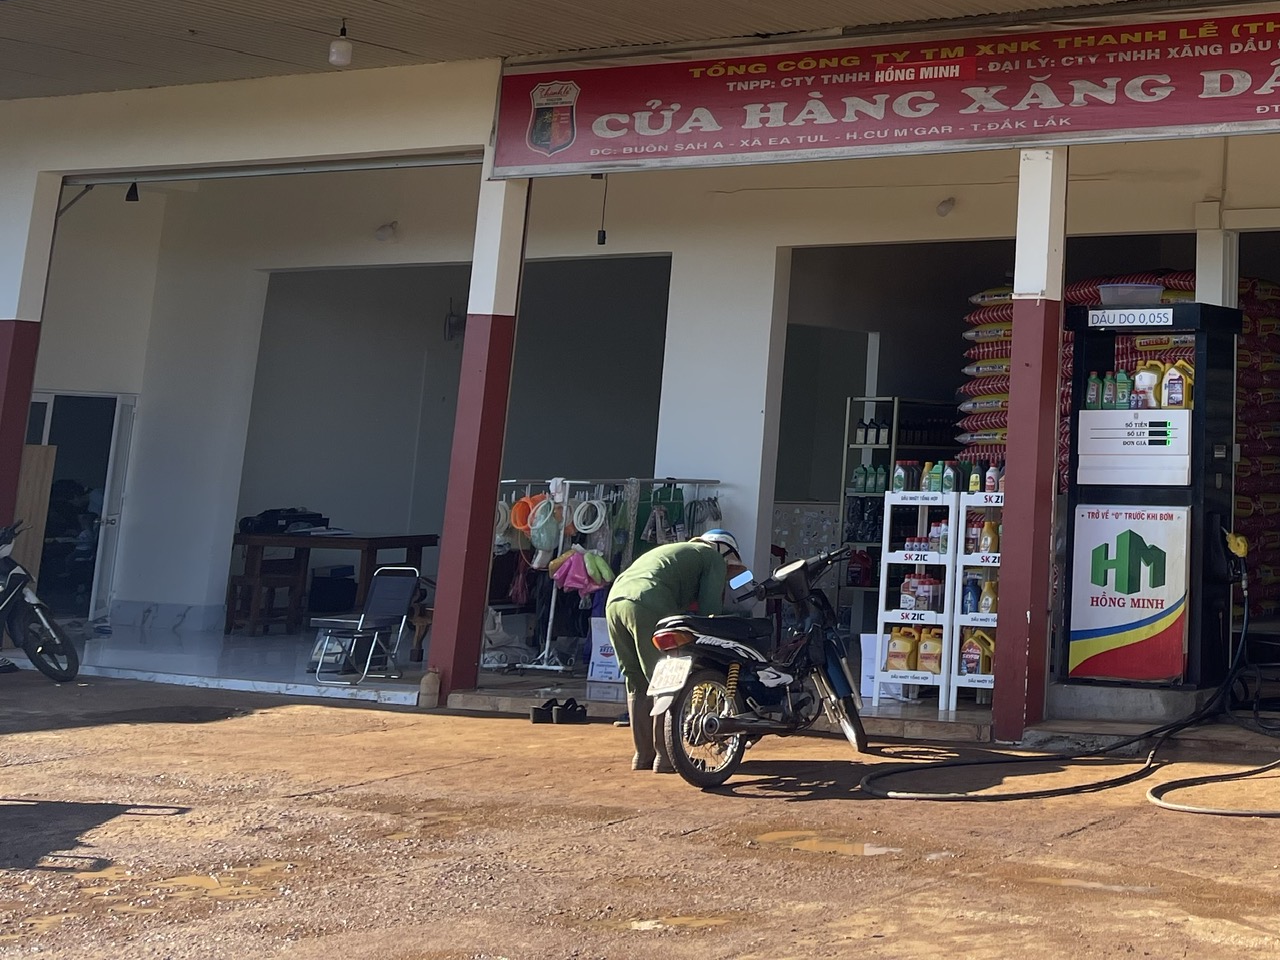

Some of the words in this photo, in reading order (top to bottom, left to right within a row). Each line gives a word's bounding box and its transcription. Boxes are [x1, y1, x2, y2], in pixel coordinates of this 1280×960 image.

[689, 61, 767, 78] TỔNG
[777, 56, 861, 72] CÔNG
[872, 51, 911, 65] TY
[921, 47, 964, 60] TM
[975, 40, 1041, 56] XNK
[1053, 31, 1166, 48] THANH
[1179, 21, 1218, 39] LỄ
[727, 80, 775, 91] TNPP:
[781, 76, 815, 87] CTY
[821, 72, 870, 84] TNHH
[919, 65, 960, 79] MINH
[988, 60, 1020, 73] ĐẠI
[1026, 55, 1055, 68] LÝ:
[1061, 54, 1099, 67] CTY
[1106, 49, 1160, 63] TNHH
[1167, 43, 1222, 58] XĂNG
[592, 99, 723, 138] CỬA
[742, 91, 940, 129] HÀNG
[959, 73, 1175, 114] XĂNG
[623, 143, 668, 155] BUÔN
[675, 141, 707, 152] SAH
[713, 141, 723, 149] A
[769, 136, 790, 146] EA
[797, 134, 829, 144] TUL
[1119, 313, 1135, 324] DO
[1139, 313, 1169, 325] 0,05S
[984, 495, 993, 503] SK
[995, 495, 1003, 503] ZI
[1087, 509, 1100, 520] TRỞ
[1147, 512, 1158, 520] KHI
[1159, 512, 1174, 521] BƠM
[1090, 592, 1126, 608] HỒNG
[1130, 597, 1165, 609] MINH
